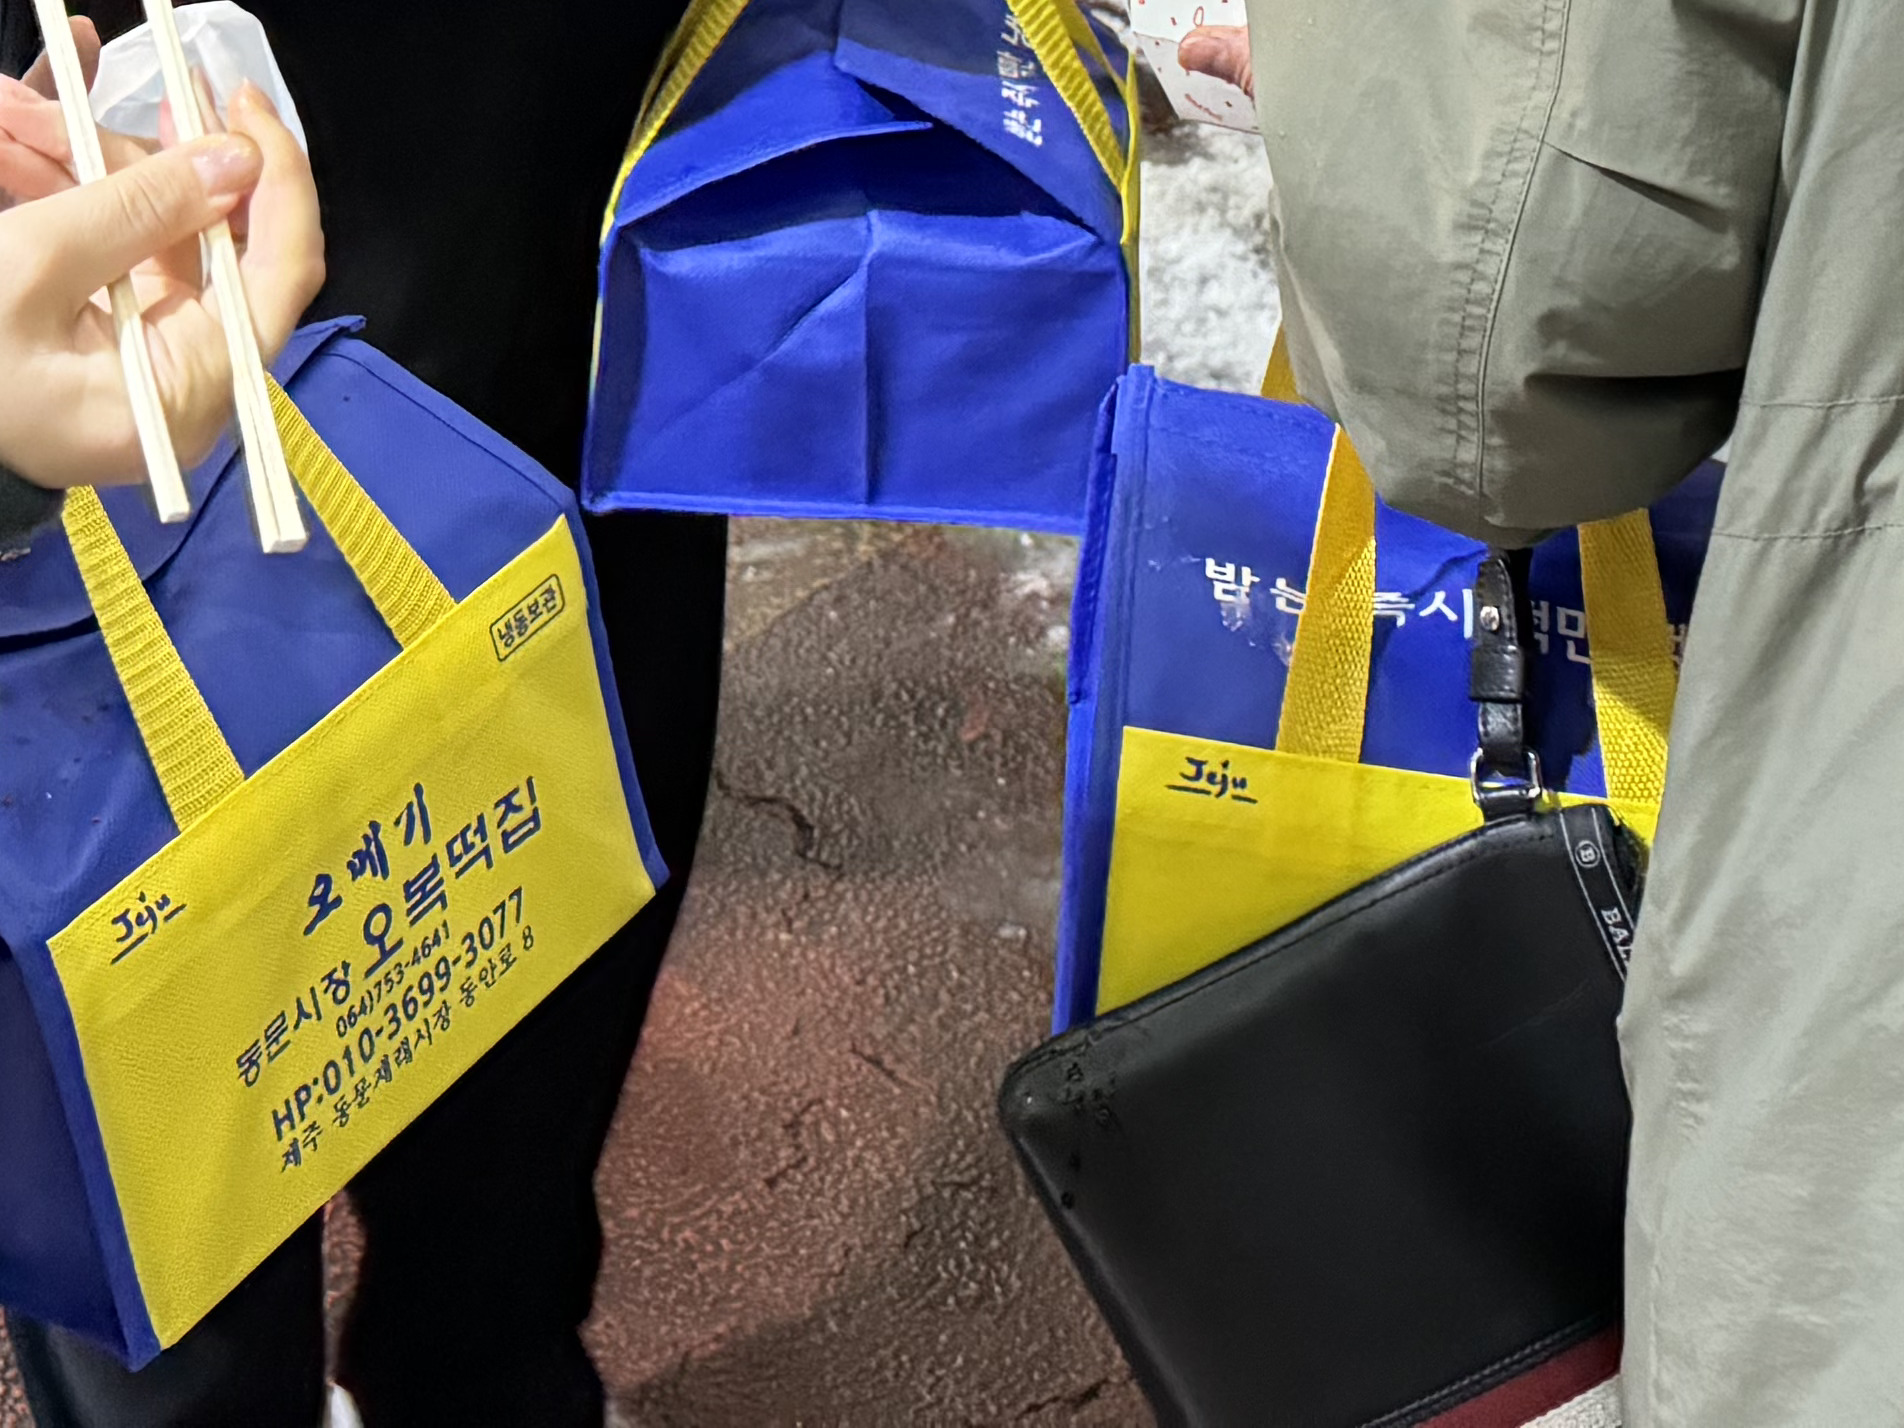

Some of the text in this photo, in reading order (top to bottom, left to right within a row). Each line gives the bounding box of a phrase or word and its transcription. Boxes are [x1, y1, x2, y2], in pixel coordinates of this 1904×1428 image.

[496, 583, 558, 649] 냉동보관
[1176, 755, 1249, 799] Jeju
[302, 781, 433, 937] 오메기
[110, 891, 172, 949] Jeju
[235, 775, 542, 1089] 동문시장 오복떡집
[520, 924, 535, 952] 8
[1600, 906, 1634, 968] BAL
[335, 918, 451, 1040] 064)753-4641
[271, 885, 524, 1143] HP:010-3699-3077
